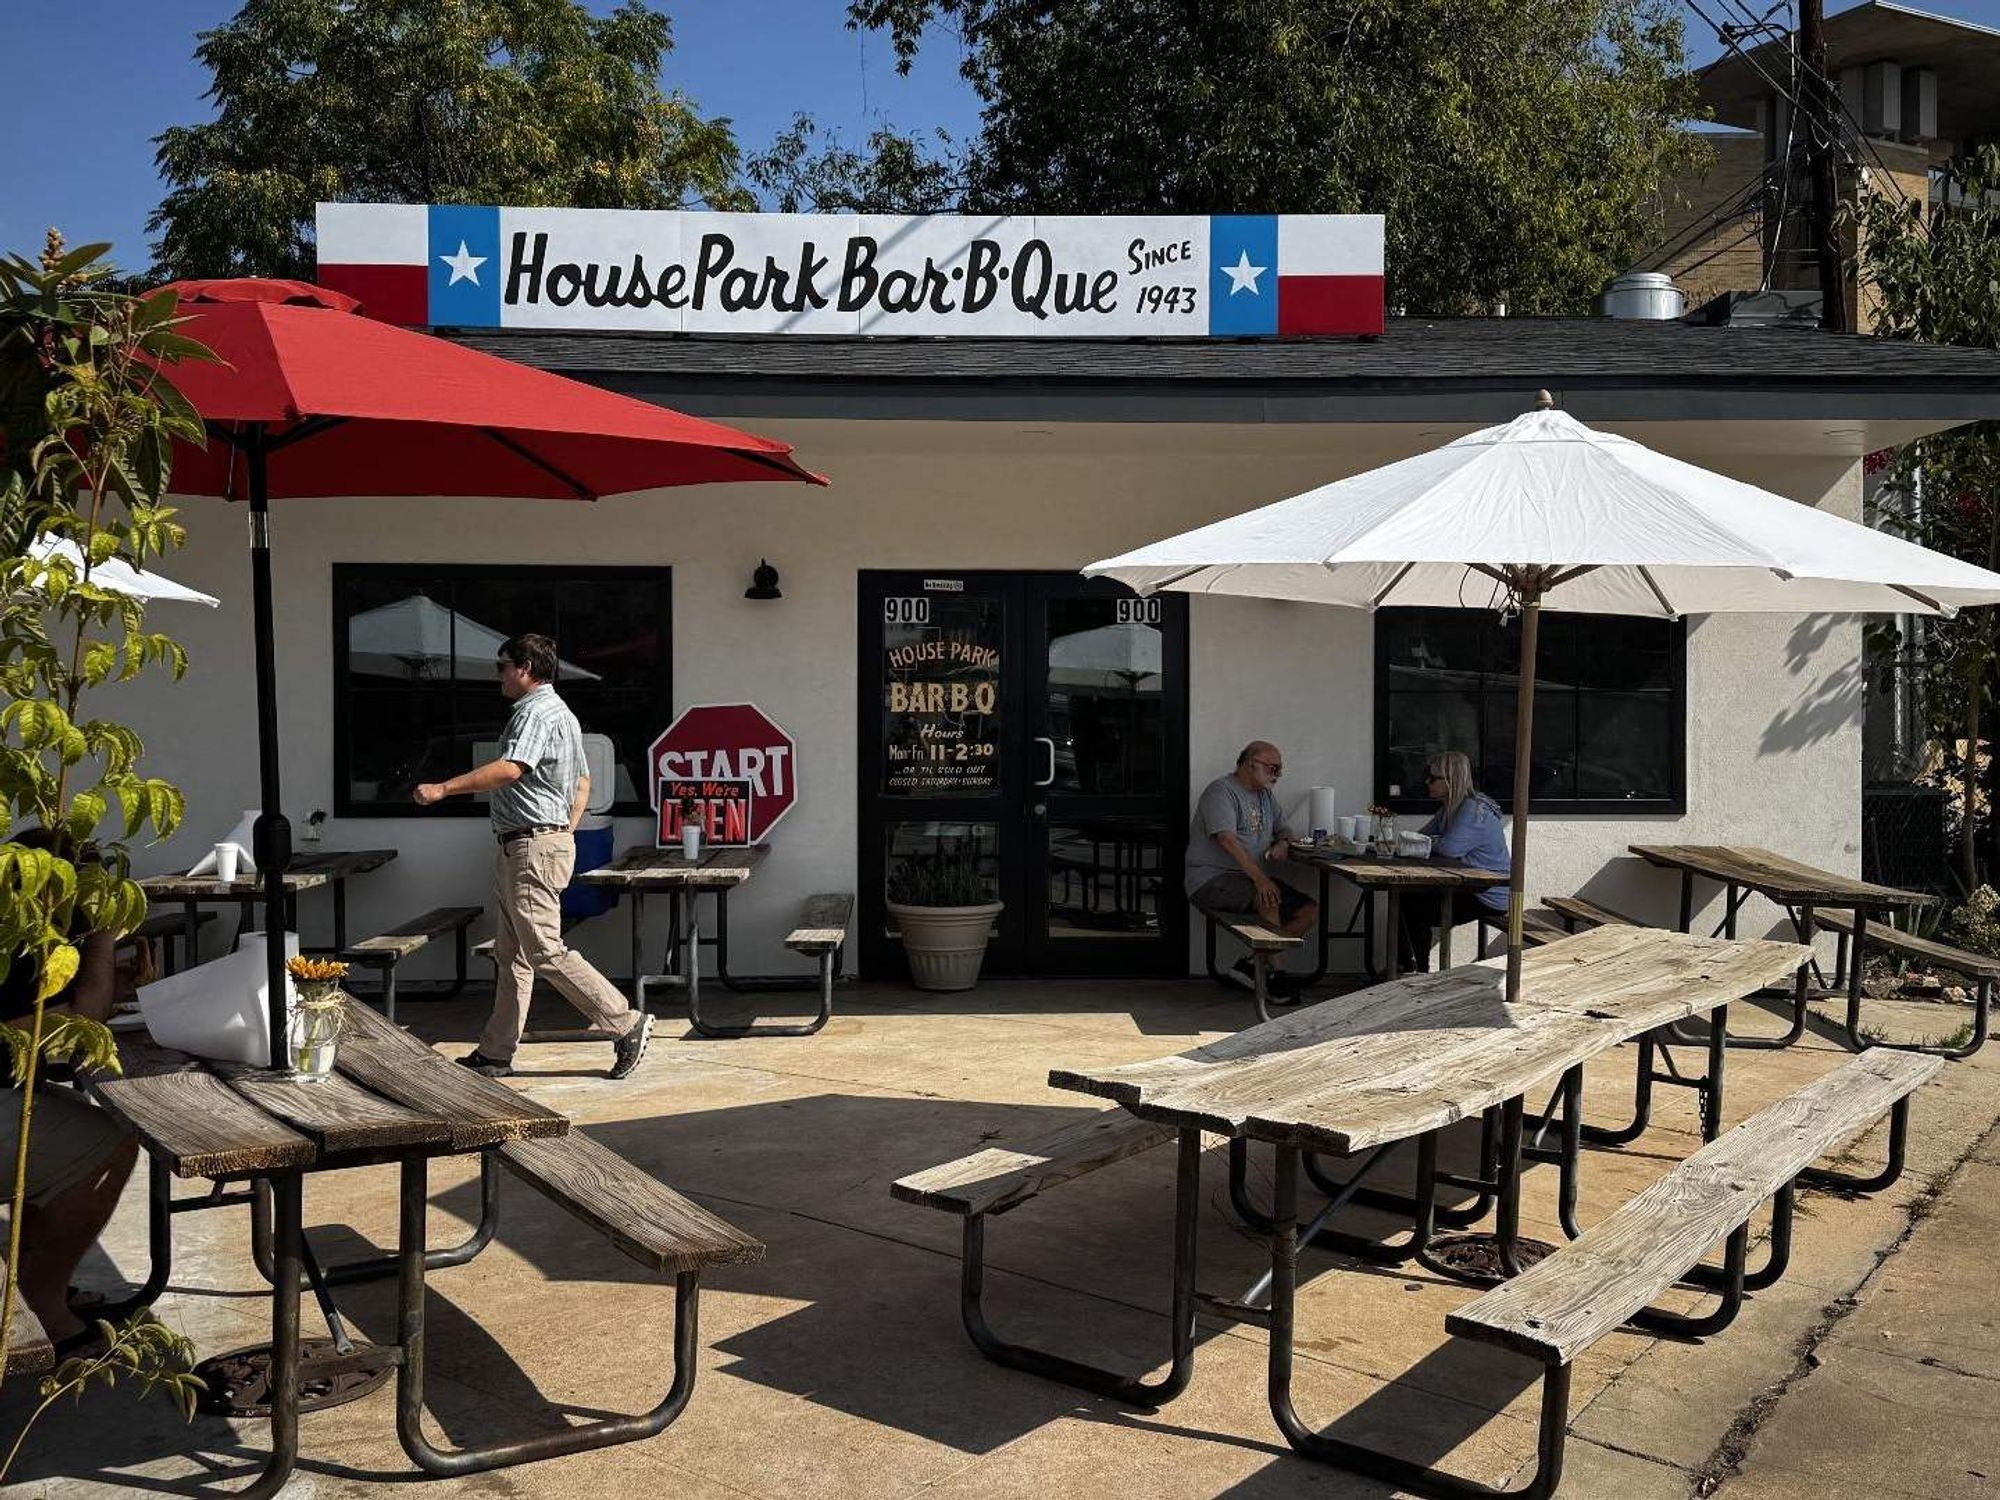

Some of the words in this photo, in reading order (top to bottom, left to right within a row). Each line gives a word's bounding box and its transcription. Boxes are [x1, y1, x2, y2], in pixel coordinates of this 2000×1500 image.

[504, 231, 690, 309] House
[691, 233, 829, 312] Park
[1135, 285, 1198, 314] 1943
[886, 598, 928, 622] 900
[1119, 600, 1160, 622] 900
[888, 641, 945, 668] HOUSE
[949, 641, 997, 668] PARK
[920, 723, 964, 739] Hours
[930, 743, 995, 761] 11-2:30
[658, 745, 789, 797] START
